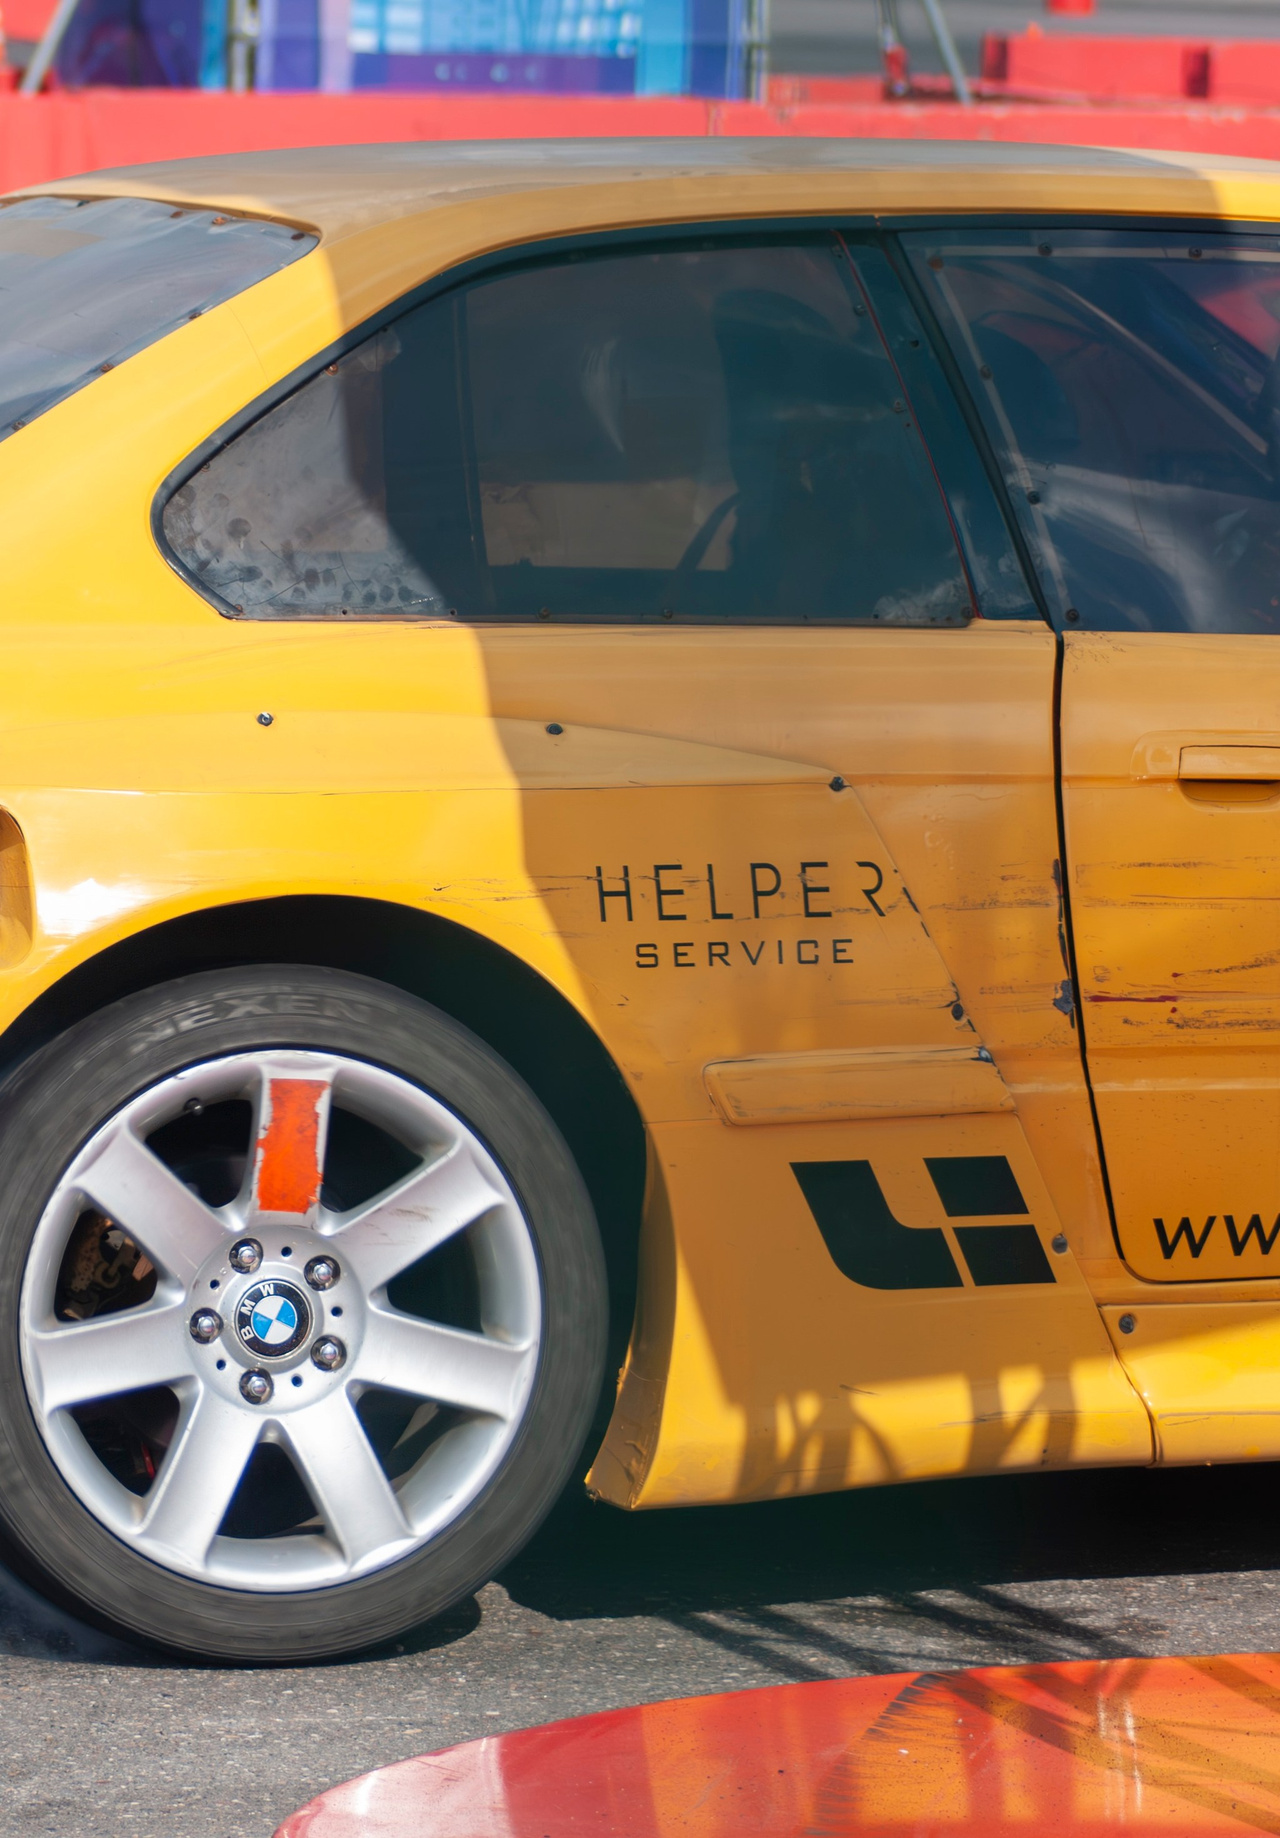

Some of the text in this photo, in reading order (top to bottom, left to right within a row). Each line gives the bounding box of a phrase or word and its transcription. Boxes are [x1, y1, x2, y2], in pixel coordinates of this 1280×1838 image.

[595, 860, 887, 922] HELPER
[635, 938, 854, 969] SERVICE
[130, 992, 373, 1056] NEXEN
[239, 1283, 275, 1342] BMW
